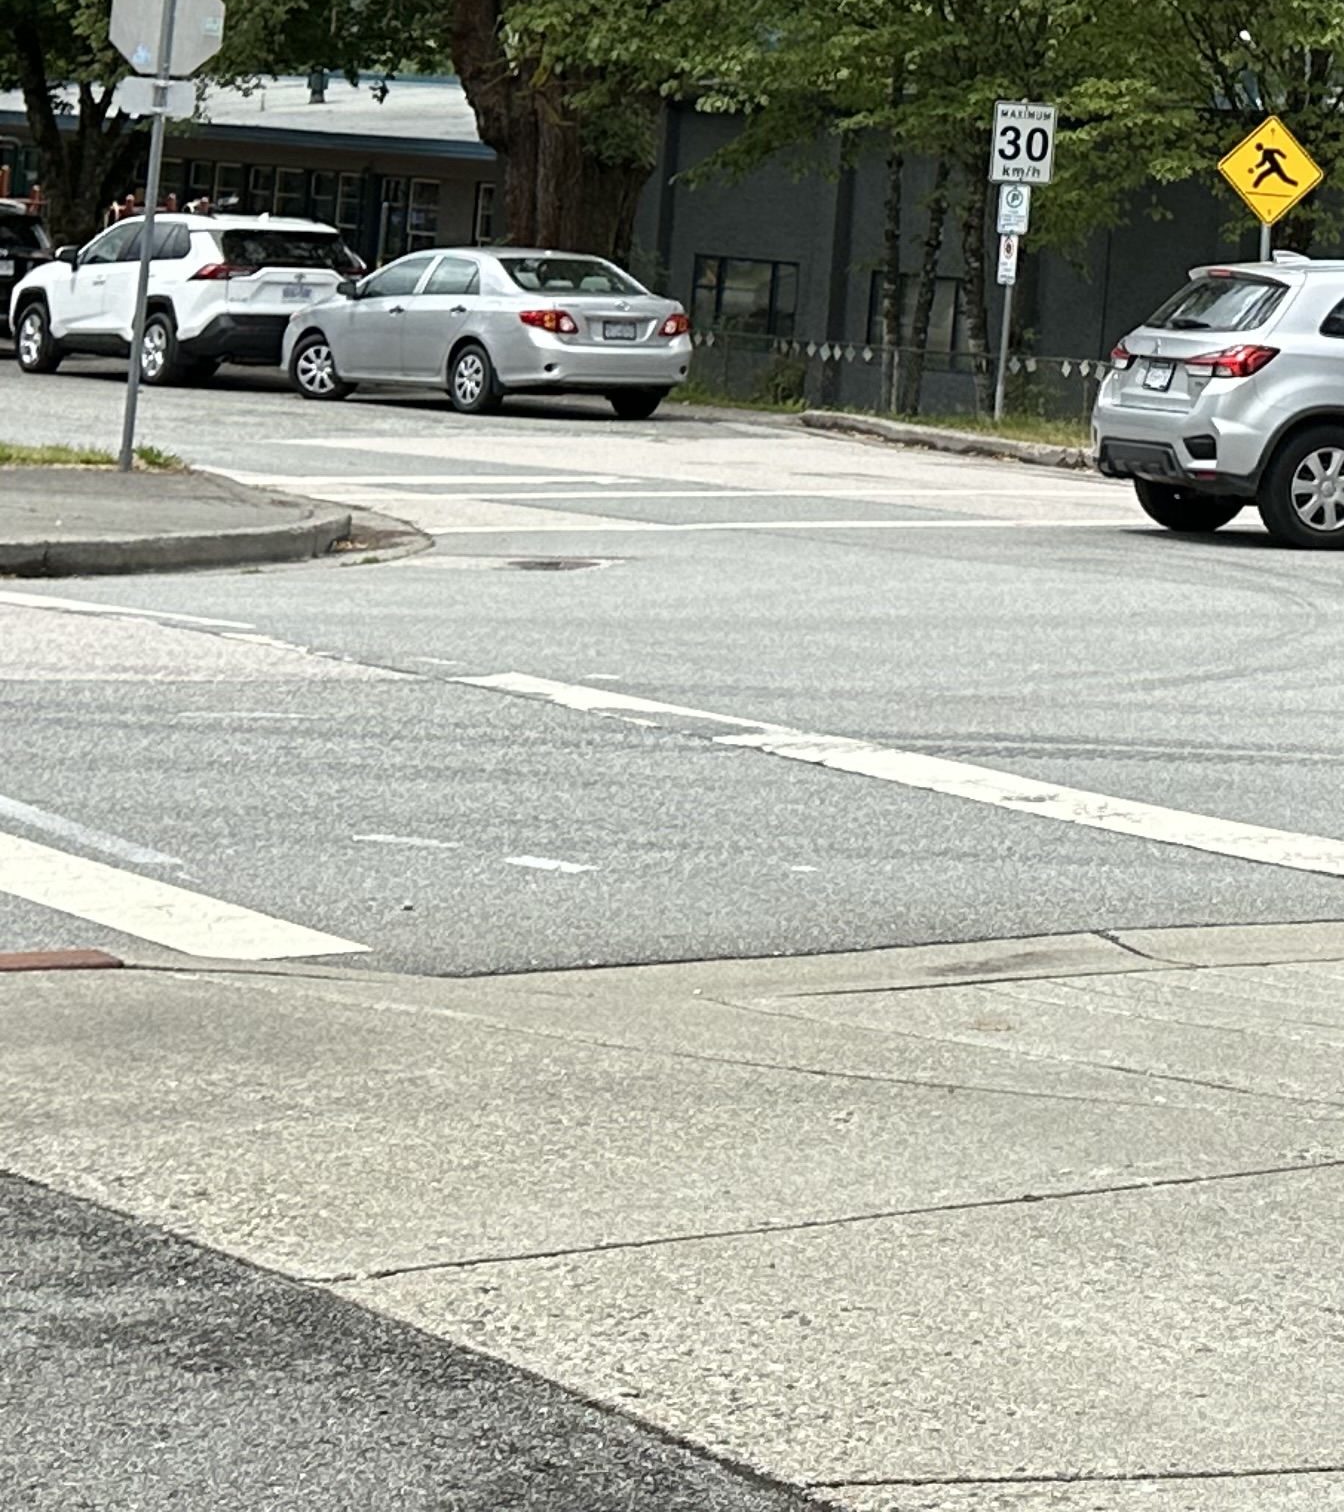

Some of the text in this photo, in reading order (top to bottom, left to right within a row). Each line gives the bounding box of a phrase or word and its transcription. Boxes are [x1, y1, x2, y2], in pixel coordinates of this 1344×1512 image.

[1001, 110, 1051, 121] MAXIMUM
[998, 125, 1049, 162] 30
[1002, 165, 1041, 178] km/h
